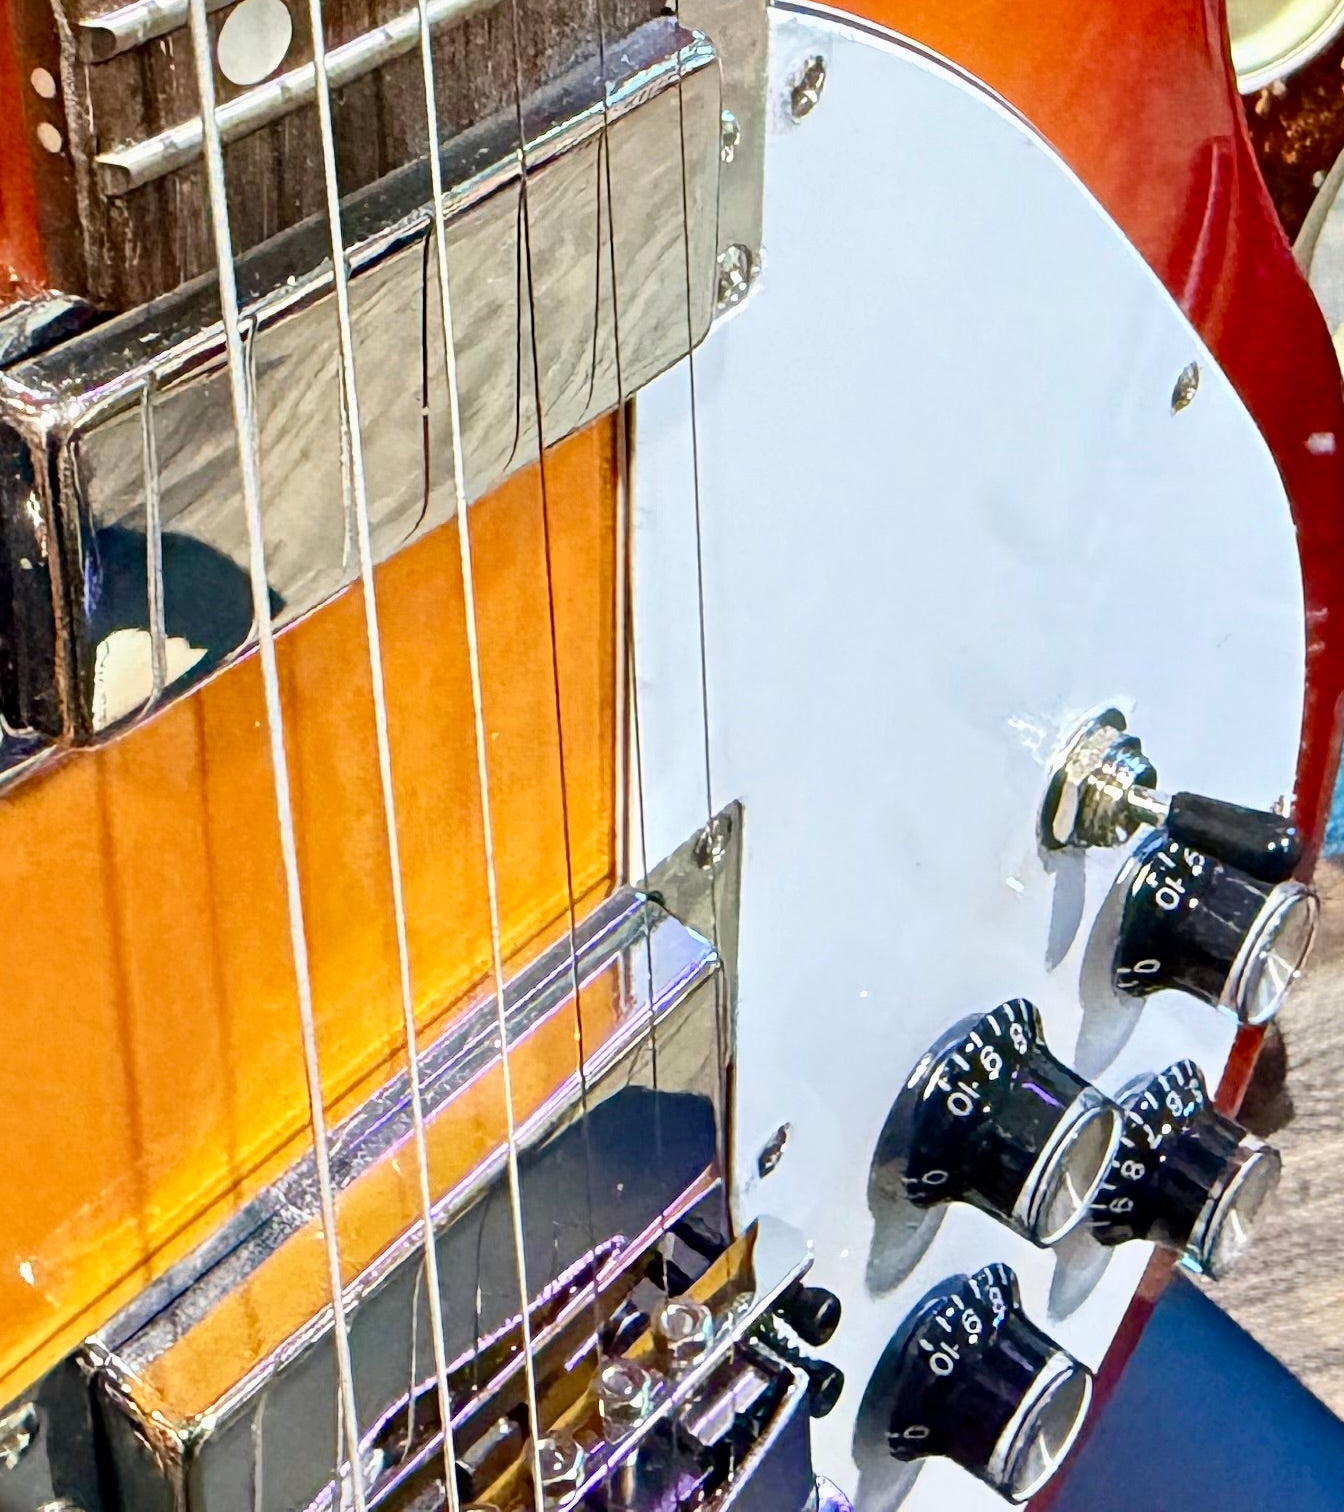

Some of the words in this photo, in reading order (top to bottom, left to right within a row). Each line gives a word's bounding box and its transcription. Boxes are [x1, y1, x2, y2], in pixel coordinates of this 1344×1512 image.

[1156, 877, 1186, 910] 10
[1133, 959, 1161, 974] 0
[947, 1080, 980, 1116] 10
[922, 1170, 948, 1185] 0
[1120, 1160, 1145, 1180] 8
[930, 1341, 960, 1376] 10
[904, 1425, 930, 1439] 0
